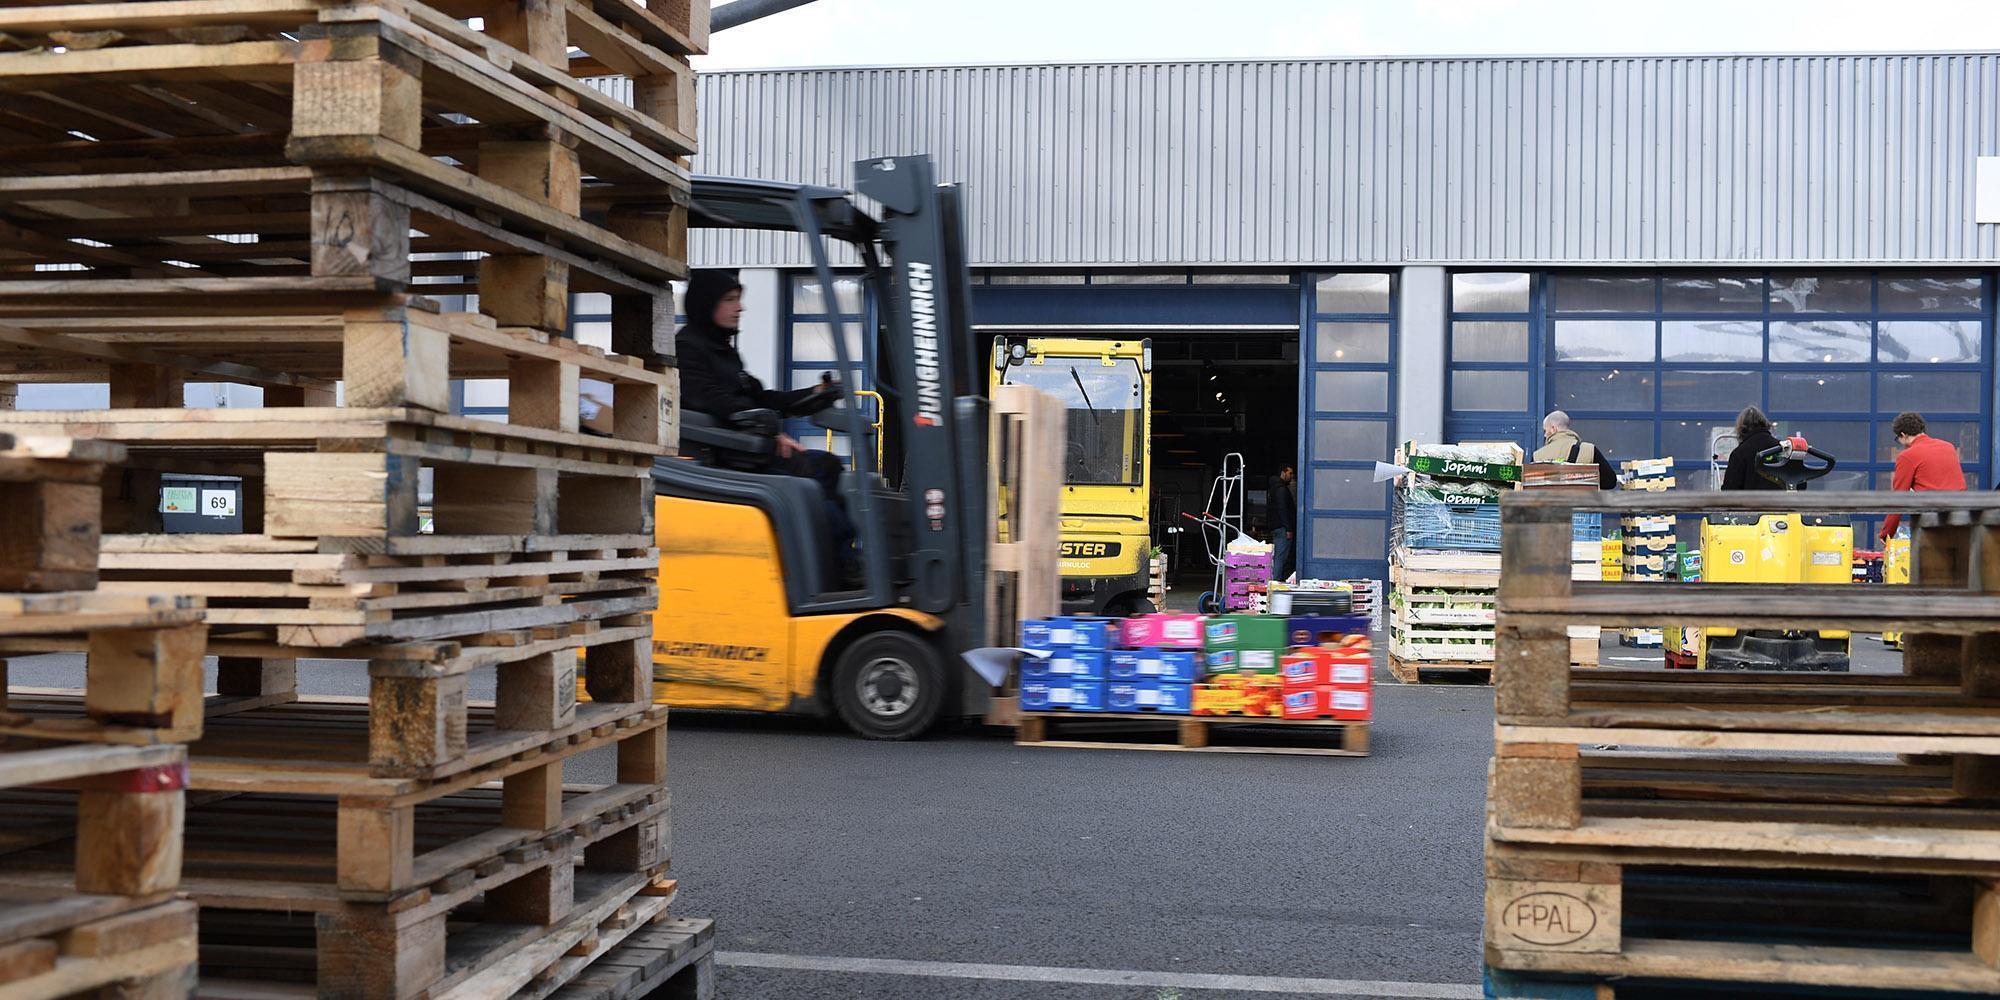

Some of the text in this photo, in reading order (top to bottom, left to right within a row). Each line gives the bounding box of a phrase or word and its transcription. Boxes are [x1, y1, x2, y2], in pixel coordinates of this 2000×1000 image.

[907, 262, 944, 427] JUNGHEINRICH
[211, 496, 227, 509] 69
[1057, 543, 1106, 555] STER
